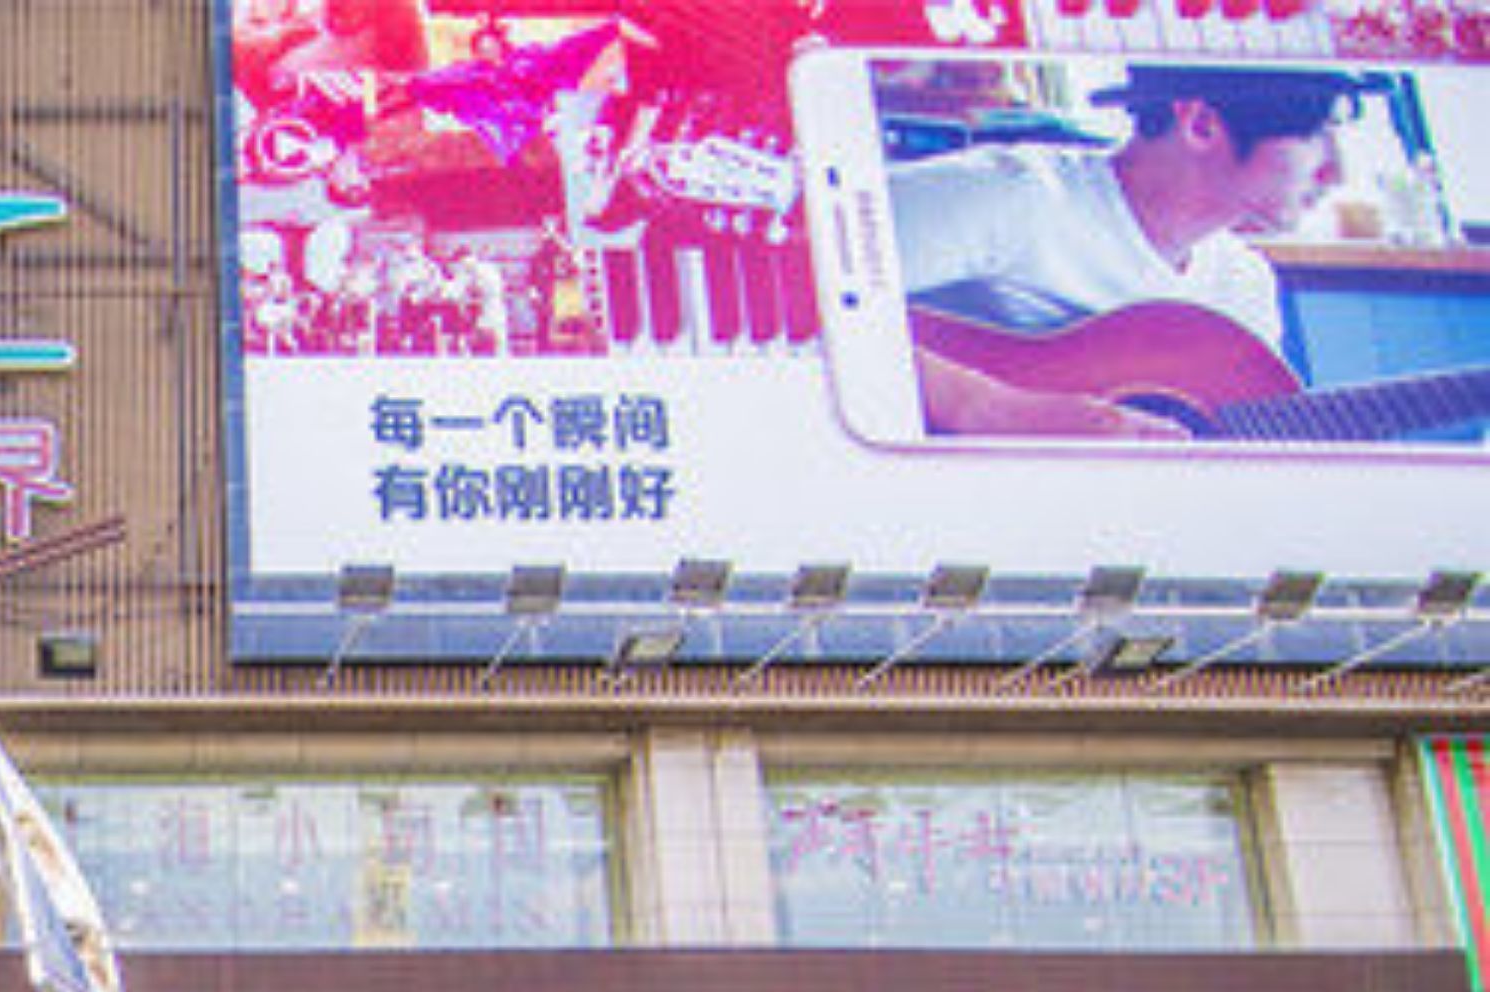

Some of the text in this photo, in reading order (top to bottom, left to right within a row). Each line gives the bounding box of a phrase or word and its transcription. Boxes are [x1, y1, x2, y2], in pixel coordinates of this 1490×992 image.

[370, 392, 670, 451] 每一个瞬间
[371, 463, 678, 521] 有你刚刚好
